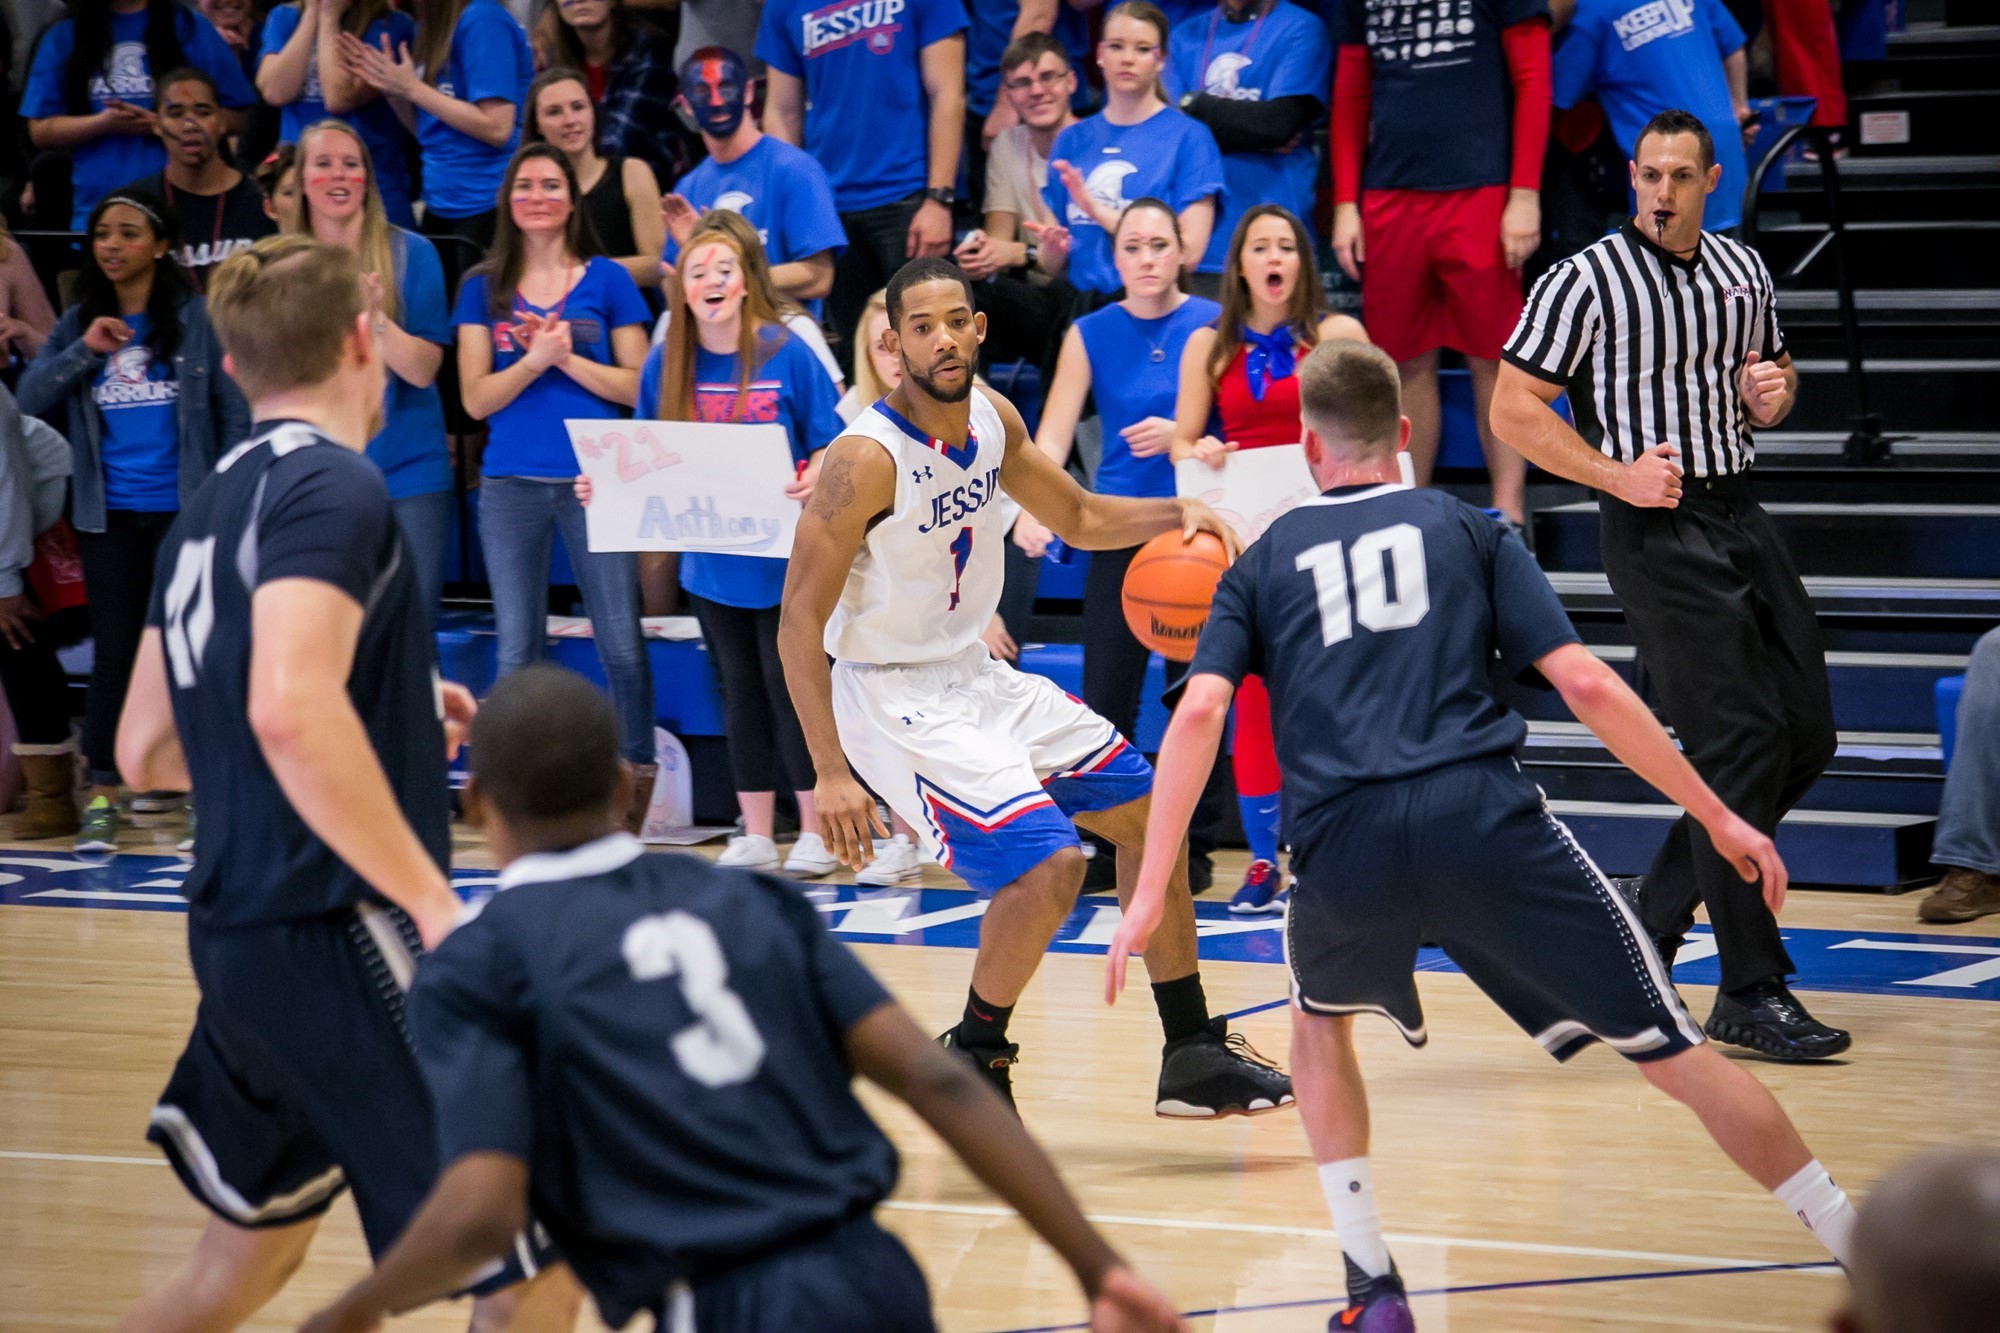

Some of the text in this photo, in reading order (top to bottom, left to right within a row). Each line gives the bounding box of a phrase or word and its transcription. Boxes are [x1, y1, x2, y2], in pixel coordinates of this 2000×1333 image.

[801, 0, 906, 56] JESSUP
[92, 380, 179, 404] ARRIORS
[578, 426, 683, 483] #21
[637, 495, 782, 552] Anthony
[948, 526, 974, 612] 1
[1294, 521, 1431, 648] 10
[620, 909, 769, 1091] 3
